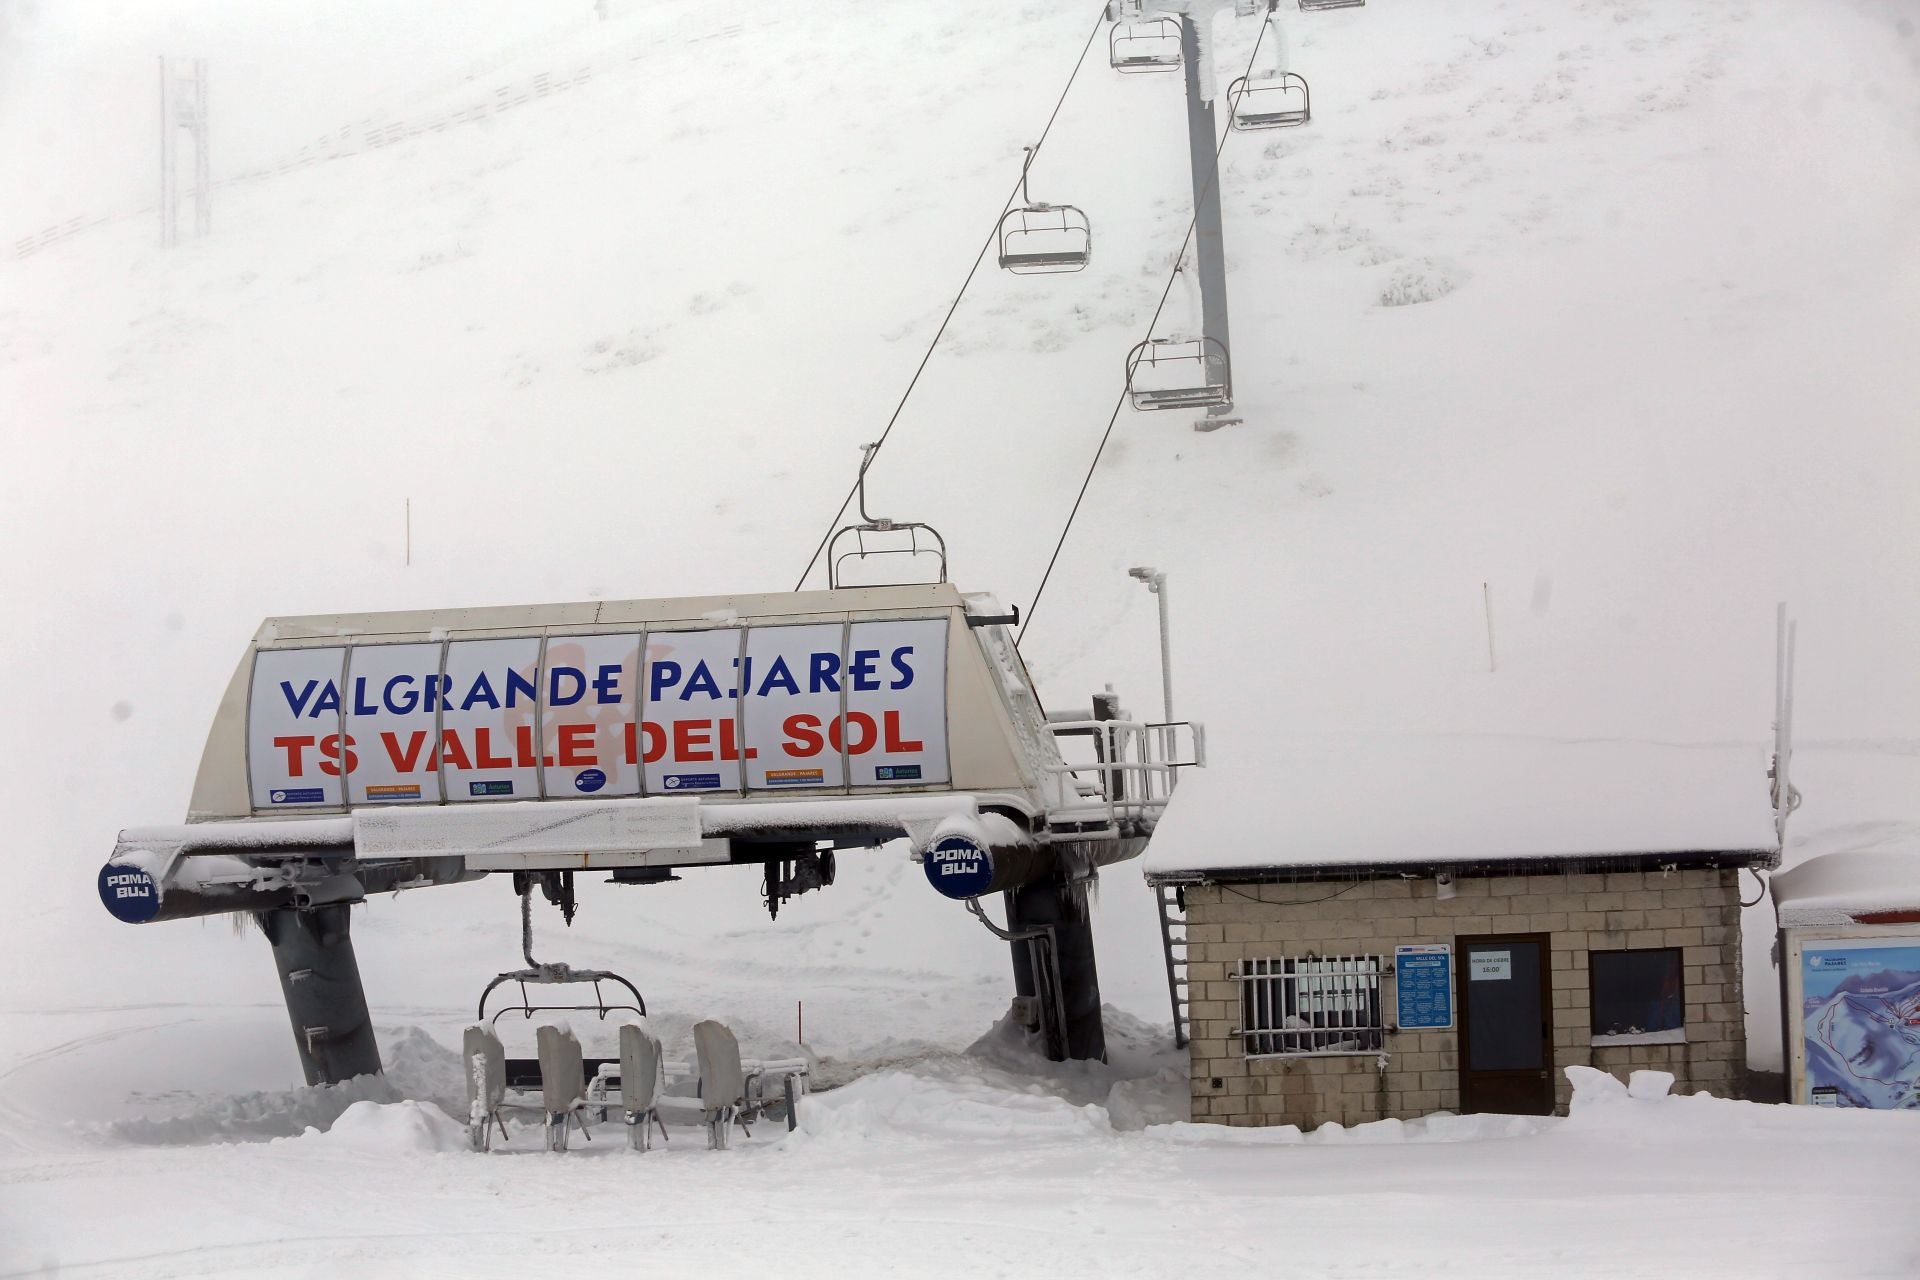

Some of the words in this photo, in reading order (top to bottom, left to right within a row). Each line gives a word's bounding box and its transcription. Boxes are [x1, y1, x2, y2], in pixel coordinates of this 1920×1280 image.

[280, 665, 622, 719] VALGRANDE
[651, 645, 914, 701] PAJARES
[273, 734, 358, 777] TS
[380, 723, 599, 773] VALLE
[624, 718, 758, 764] DEL
[782, 710, 923, 757] SOL
[933, 848, 983, 863] POMA
[941, 862, 978, 876] BUJ
[107, 874, 151, 886] POMA
[116, 887, 149, 898] BUJ
